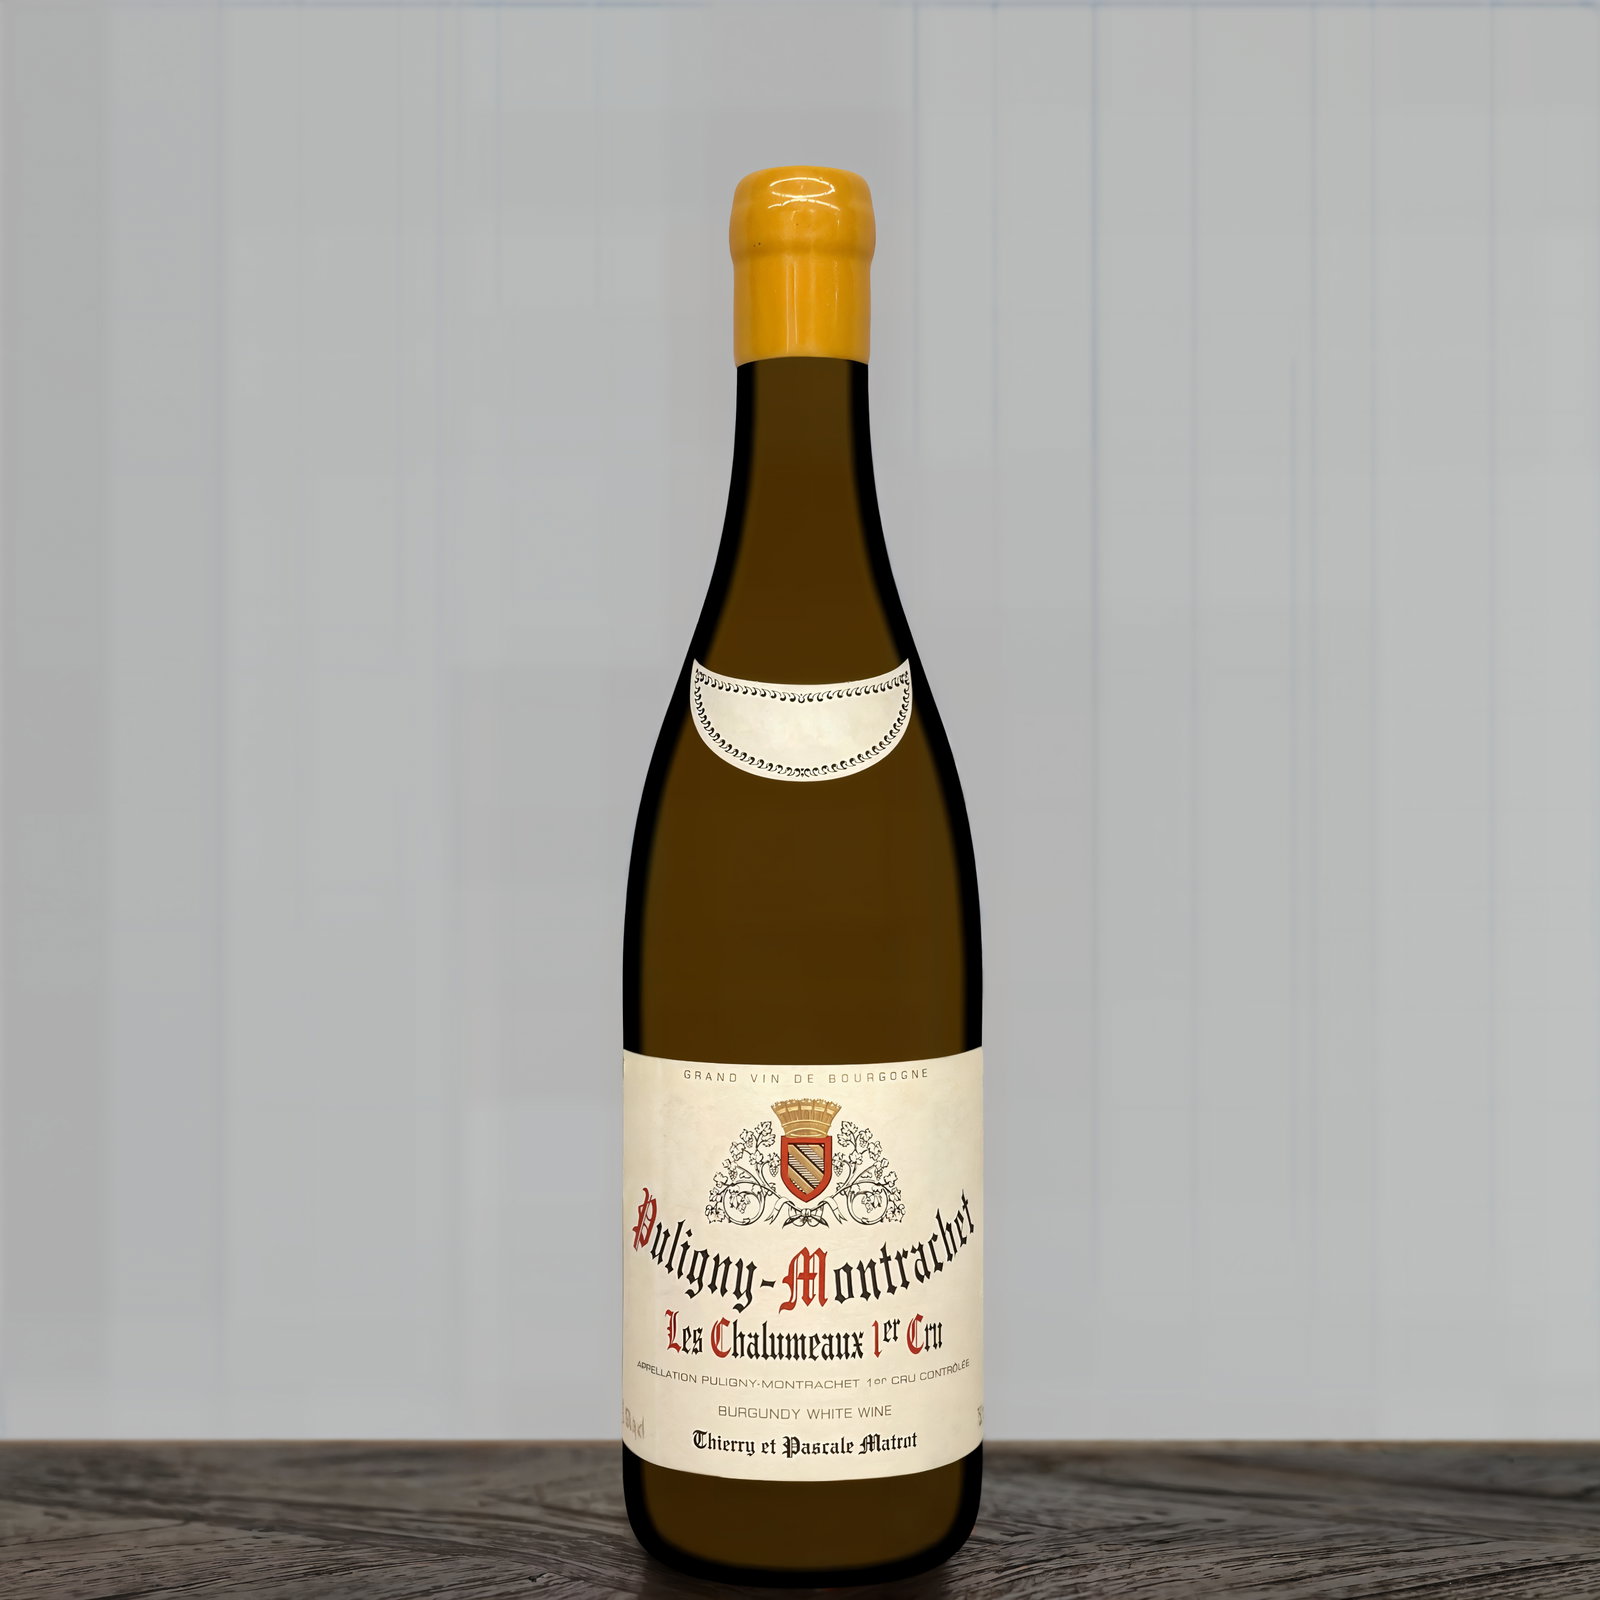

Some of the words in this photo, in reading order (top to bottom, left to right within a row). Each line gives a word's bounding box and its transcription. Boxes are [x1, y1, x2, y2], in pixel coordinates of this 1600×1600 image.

[683, 1069, 738, 1084] GRAND
[750, 1073, 780, 1084] VIN
[794, 1073, 815, 1084] DE
[828, 1067, 929, 1084] BOURGOGNE
[632, 1187, 975, 1315] Puligny-Montrachet
[664, 1309, 703, 1355] Les
[710, 1317, 864, 1361] Chalumeaux
[871, 1318, 899, 1358] 1er
[906, 1313, 944, 1355] Cru
[636, 1360, 698, 1384] APPELLATION
[891, 1373, 917, 1386] CRU
[919, 1358, 971, 1382] CONTRÔLÉE
[718, 1405, 801, 1420] BURGUNDY
[807, 1407, 853, 1419] WHITE
[858, 1404, 893, 1417] WINE
[692, 1429, 755, 1457] Thierry
[761, 1437, 777, 1455] et
[782, 1435, 855, 1459] Pascale
[857, 1431, 919, 1456] Matrot
